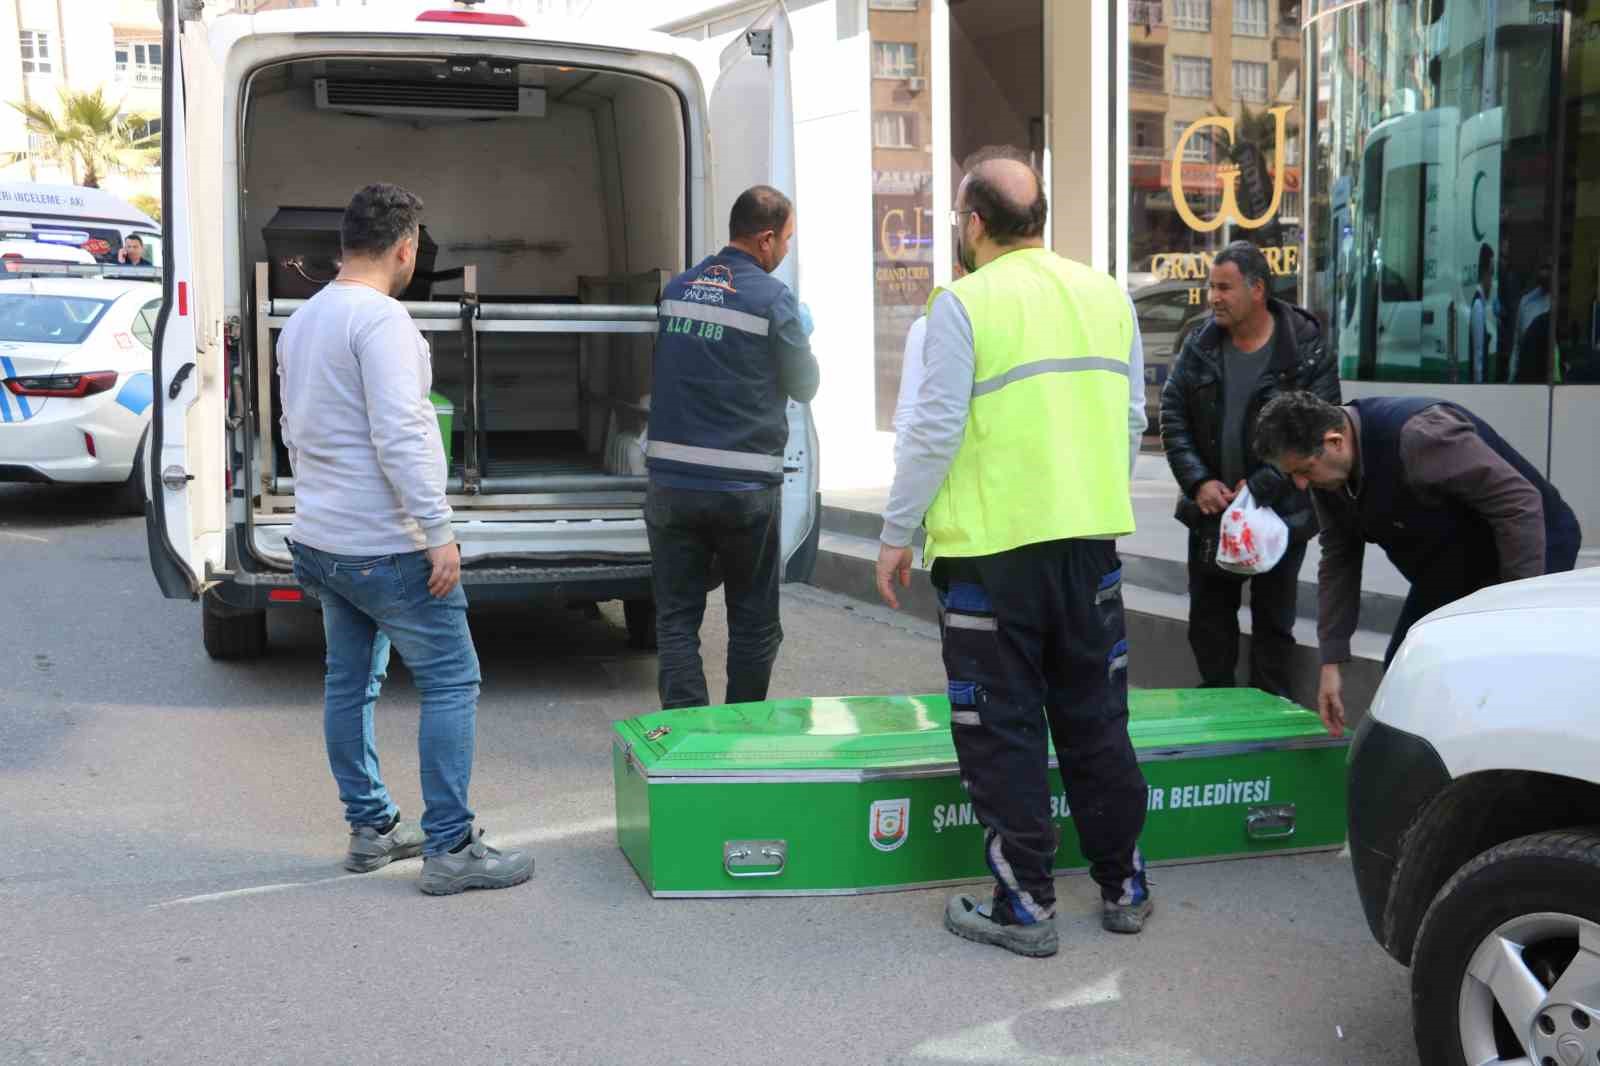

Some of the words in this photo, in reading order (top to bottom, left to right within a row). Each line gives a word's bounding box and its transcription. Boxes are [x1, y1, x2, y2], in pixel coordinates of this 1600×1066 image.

[1151, 252, 1217, 280] GRAN
[667, 318, 692, 333] ALO
[698, 322, 724, 340] 188
[1170, 776, 1271, 808] BELEDİYESİ
